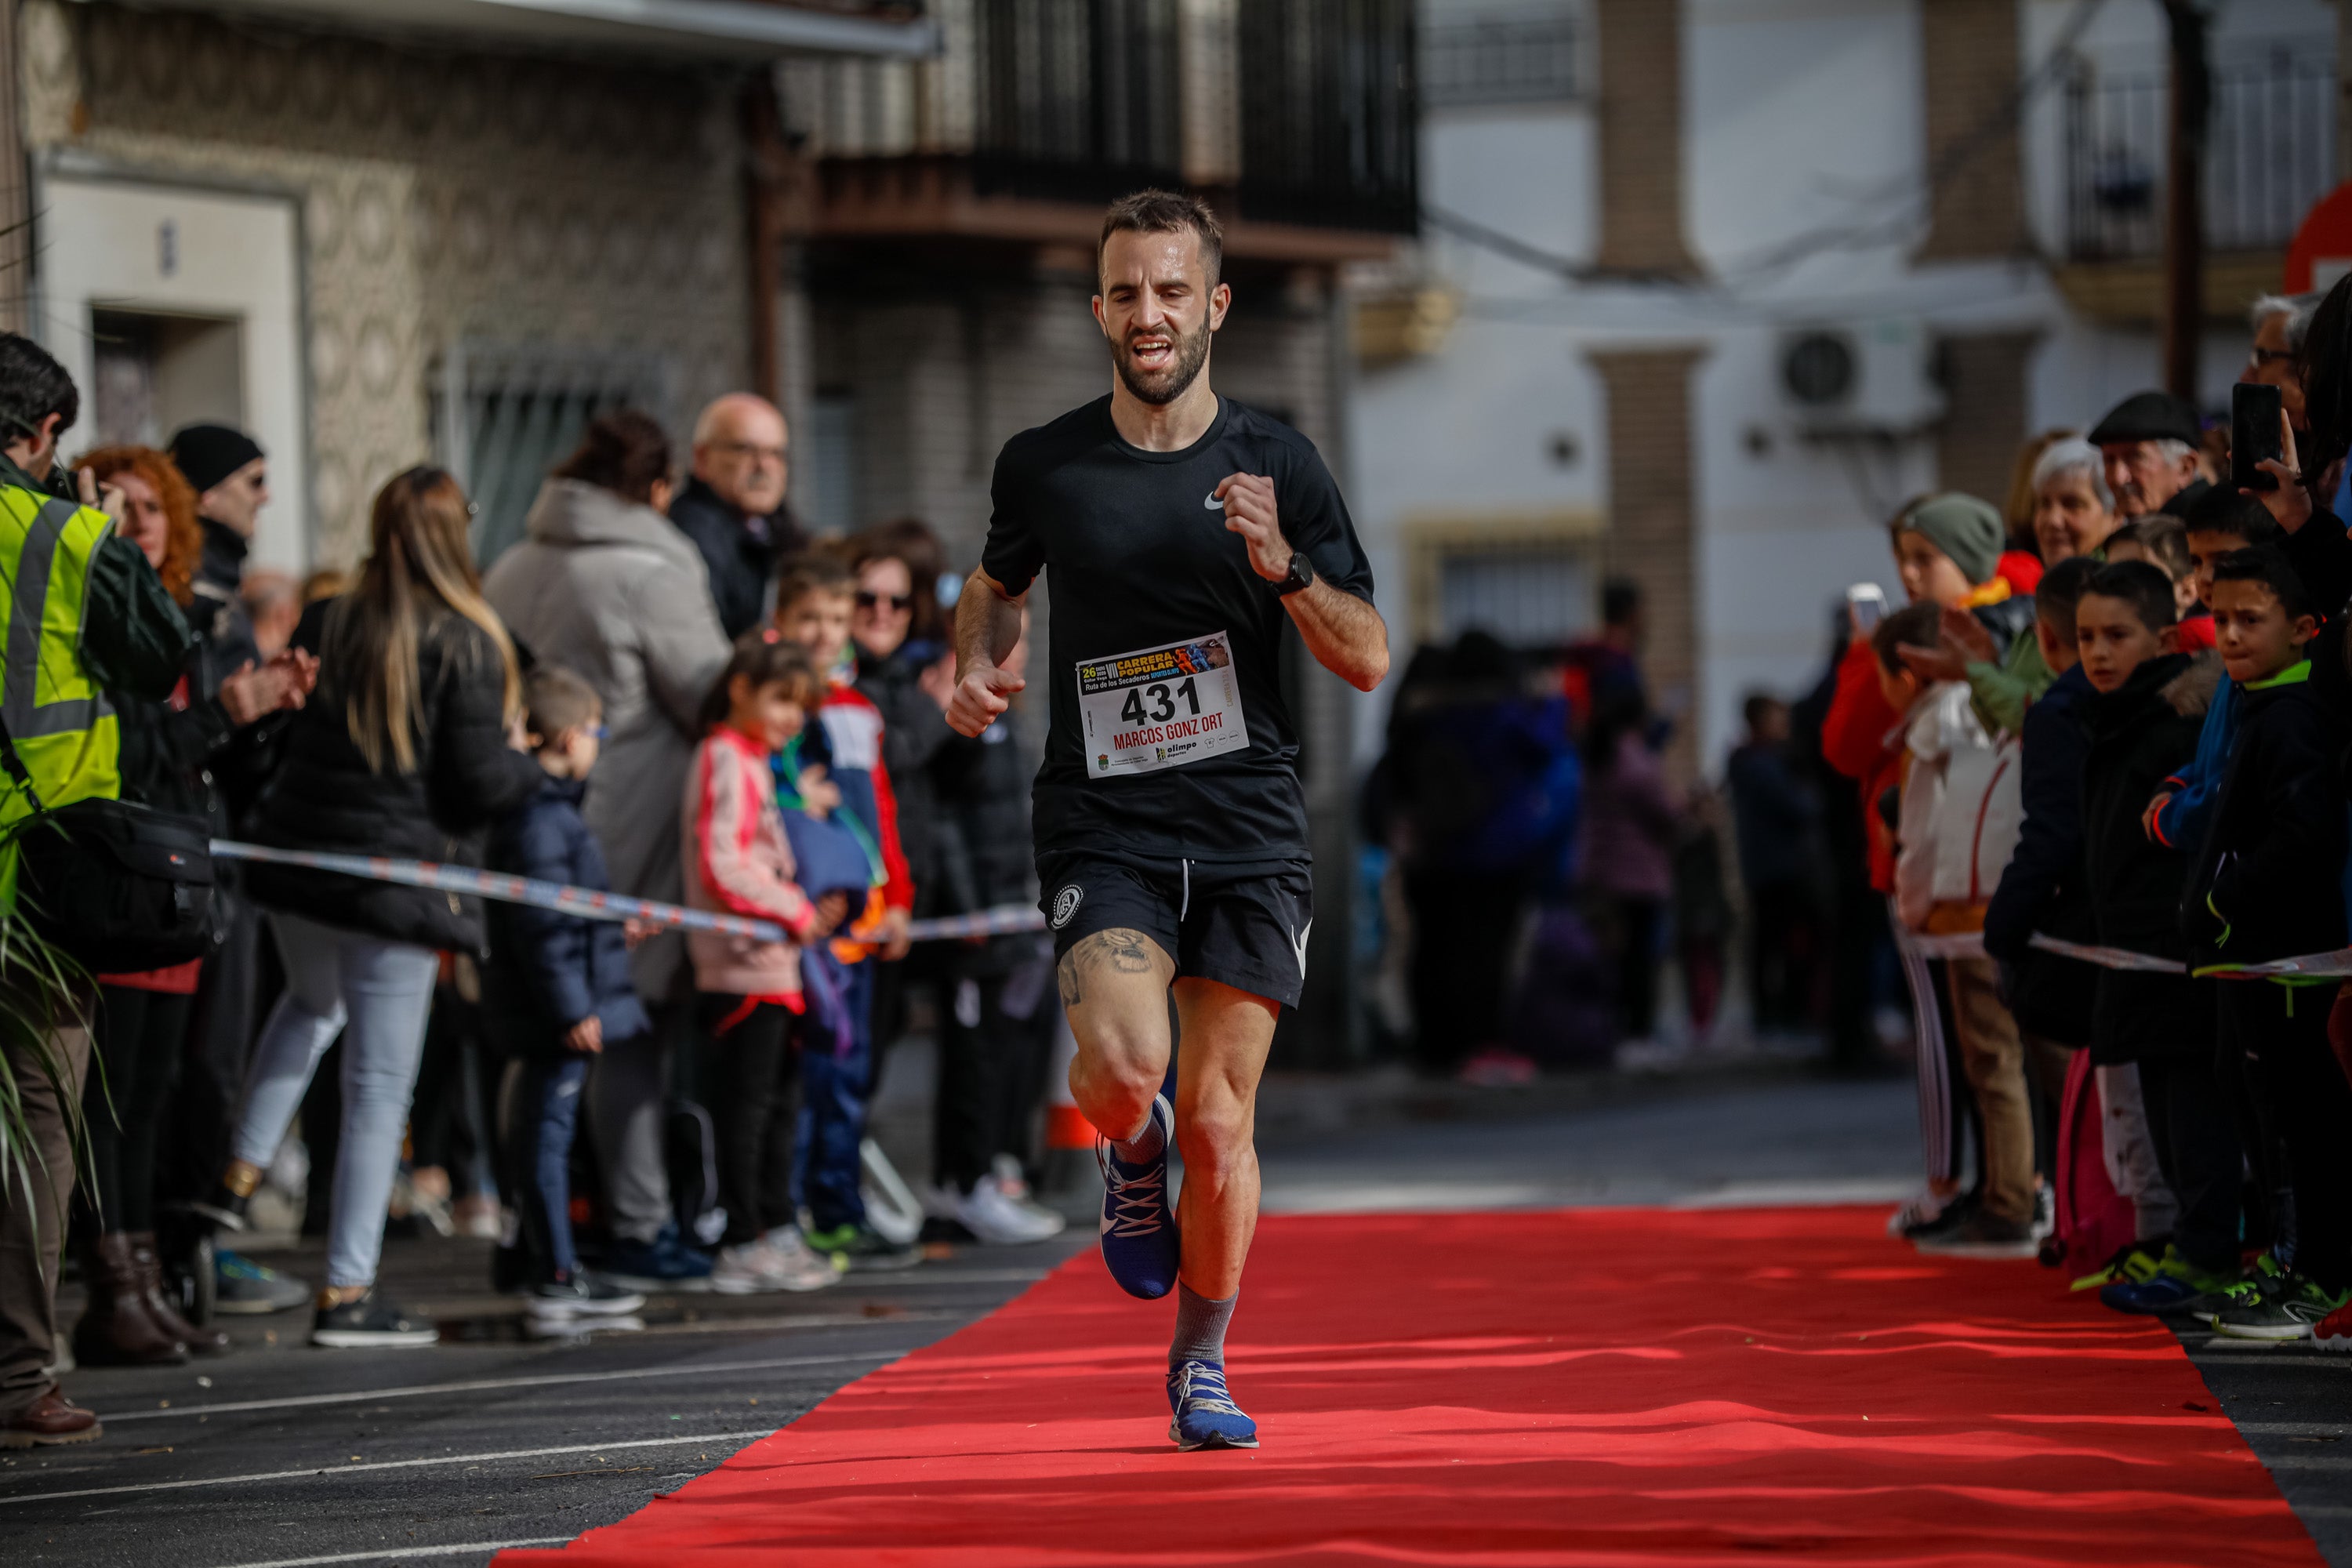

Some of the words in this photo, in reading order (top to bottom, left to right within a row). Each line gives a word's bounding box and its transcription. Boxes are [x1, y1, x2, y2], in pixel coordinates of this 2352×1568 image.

[1083, 666, 1096, 679] 26
[1105, 662, 1119, 679] VII
[1116, 652, 1173, 670] CARRERA
[1119, 661, 1174, 677] POPULAR
[1118, 674, 1149, 685] Secaderos
[1121, 677, 1200, 726] 431
[1113, 727, 1164, 750] MARCOS
[1166, 719, 1200, 740] GONZ
[1201, 712, 1223, 731] ORT
[1167, 742, 1197, 753] olimpo
